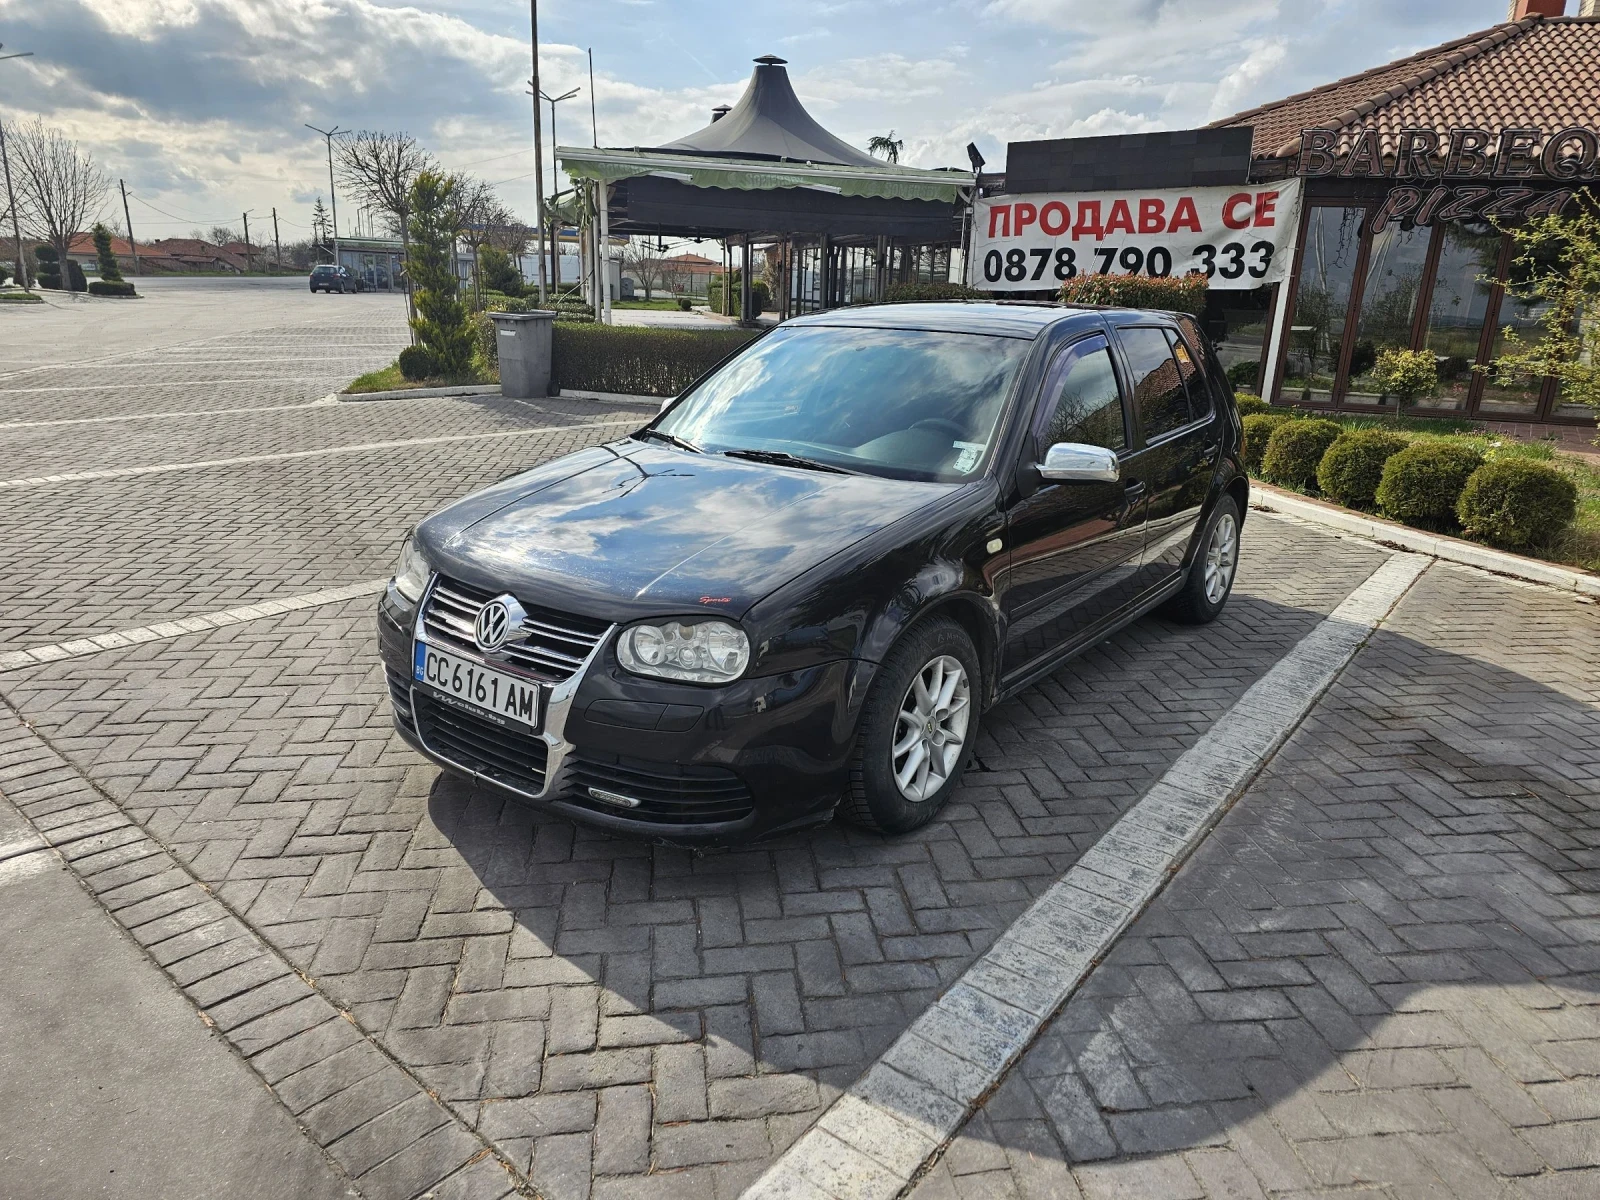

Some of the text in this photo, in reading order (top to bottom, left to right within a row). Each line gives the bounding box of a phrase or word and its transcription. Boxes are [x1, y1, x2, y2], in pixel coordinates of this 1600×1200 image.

[1295, 127, 1600, 181] BARBEQ
[988, 191, 1279, 241] ПРОДАВА СЕ
[984, 241, 1275, 282] 0878 790 333
